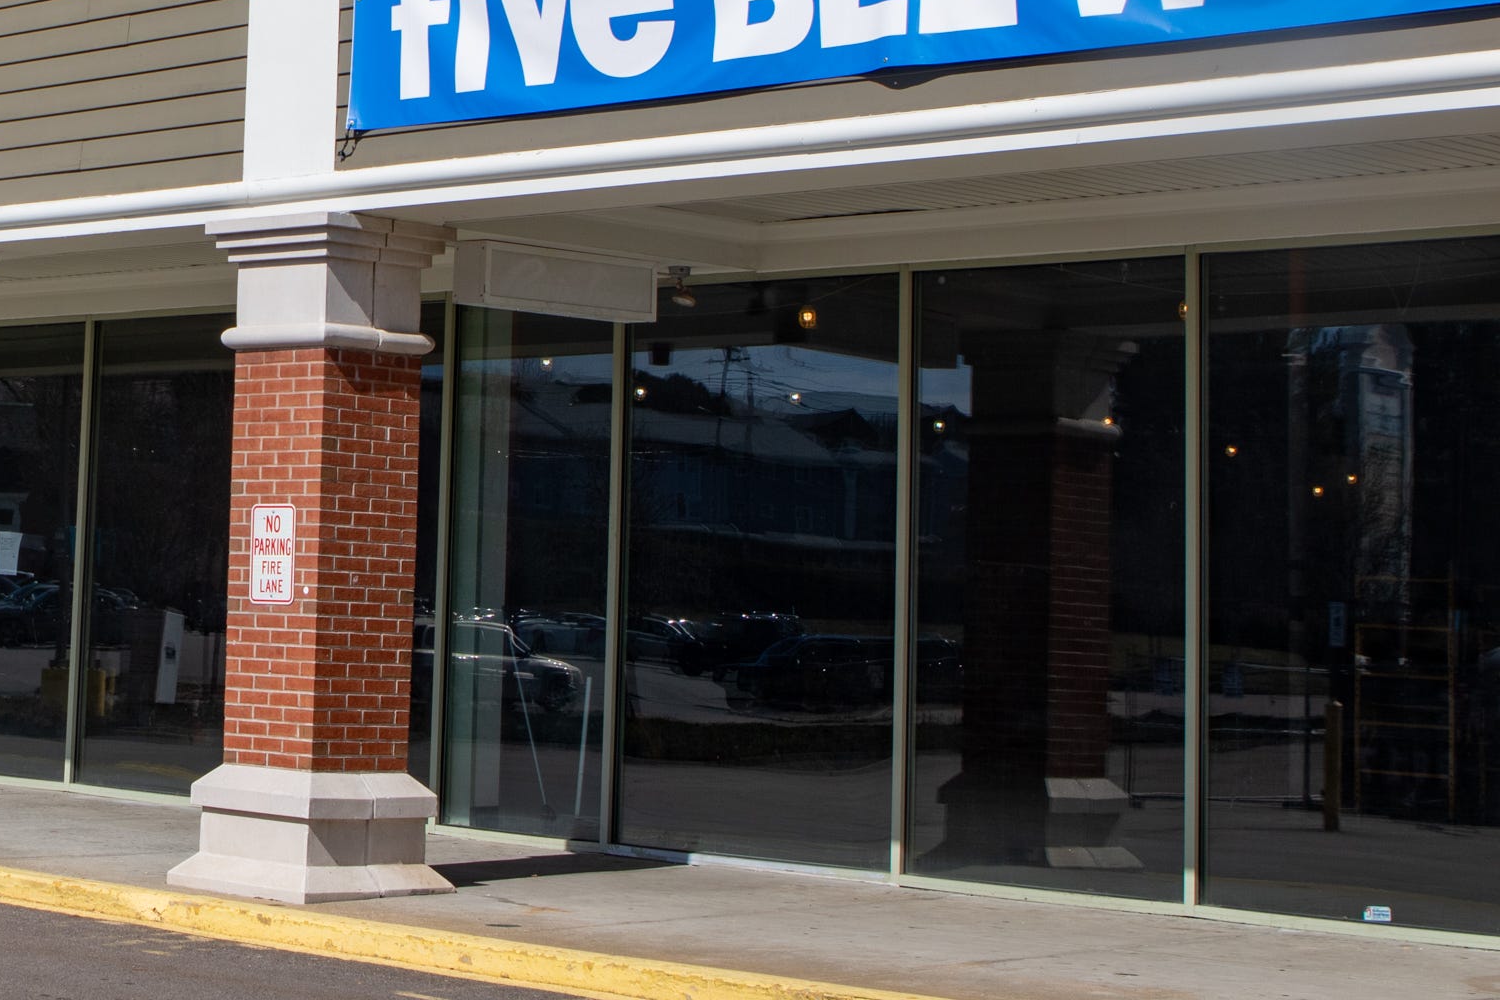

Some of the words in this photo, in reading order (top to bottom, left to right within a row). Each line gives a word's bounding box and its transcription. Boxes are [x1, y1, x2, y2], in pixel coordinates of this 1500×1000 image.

[265, 515, 281, 533] NO
[254, 538, 291, 556] PARKING
[262, 561, 282, 575] FIRE
[260, 579, 283, 593] LANE
